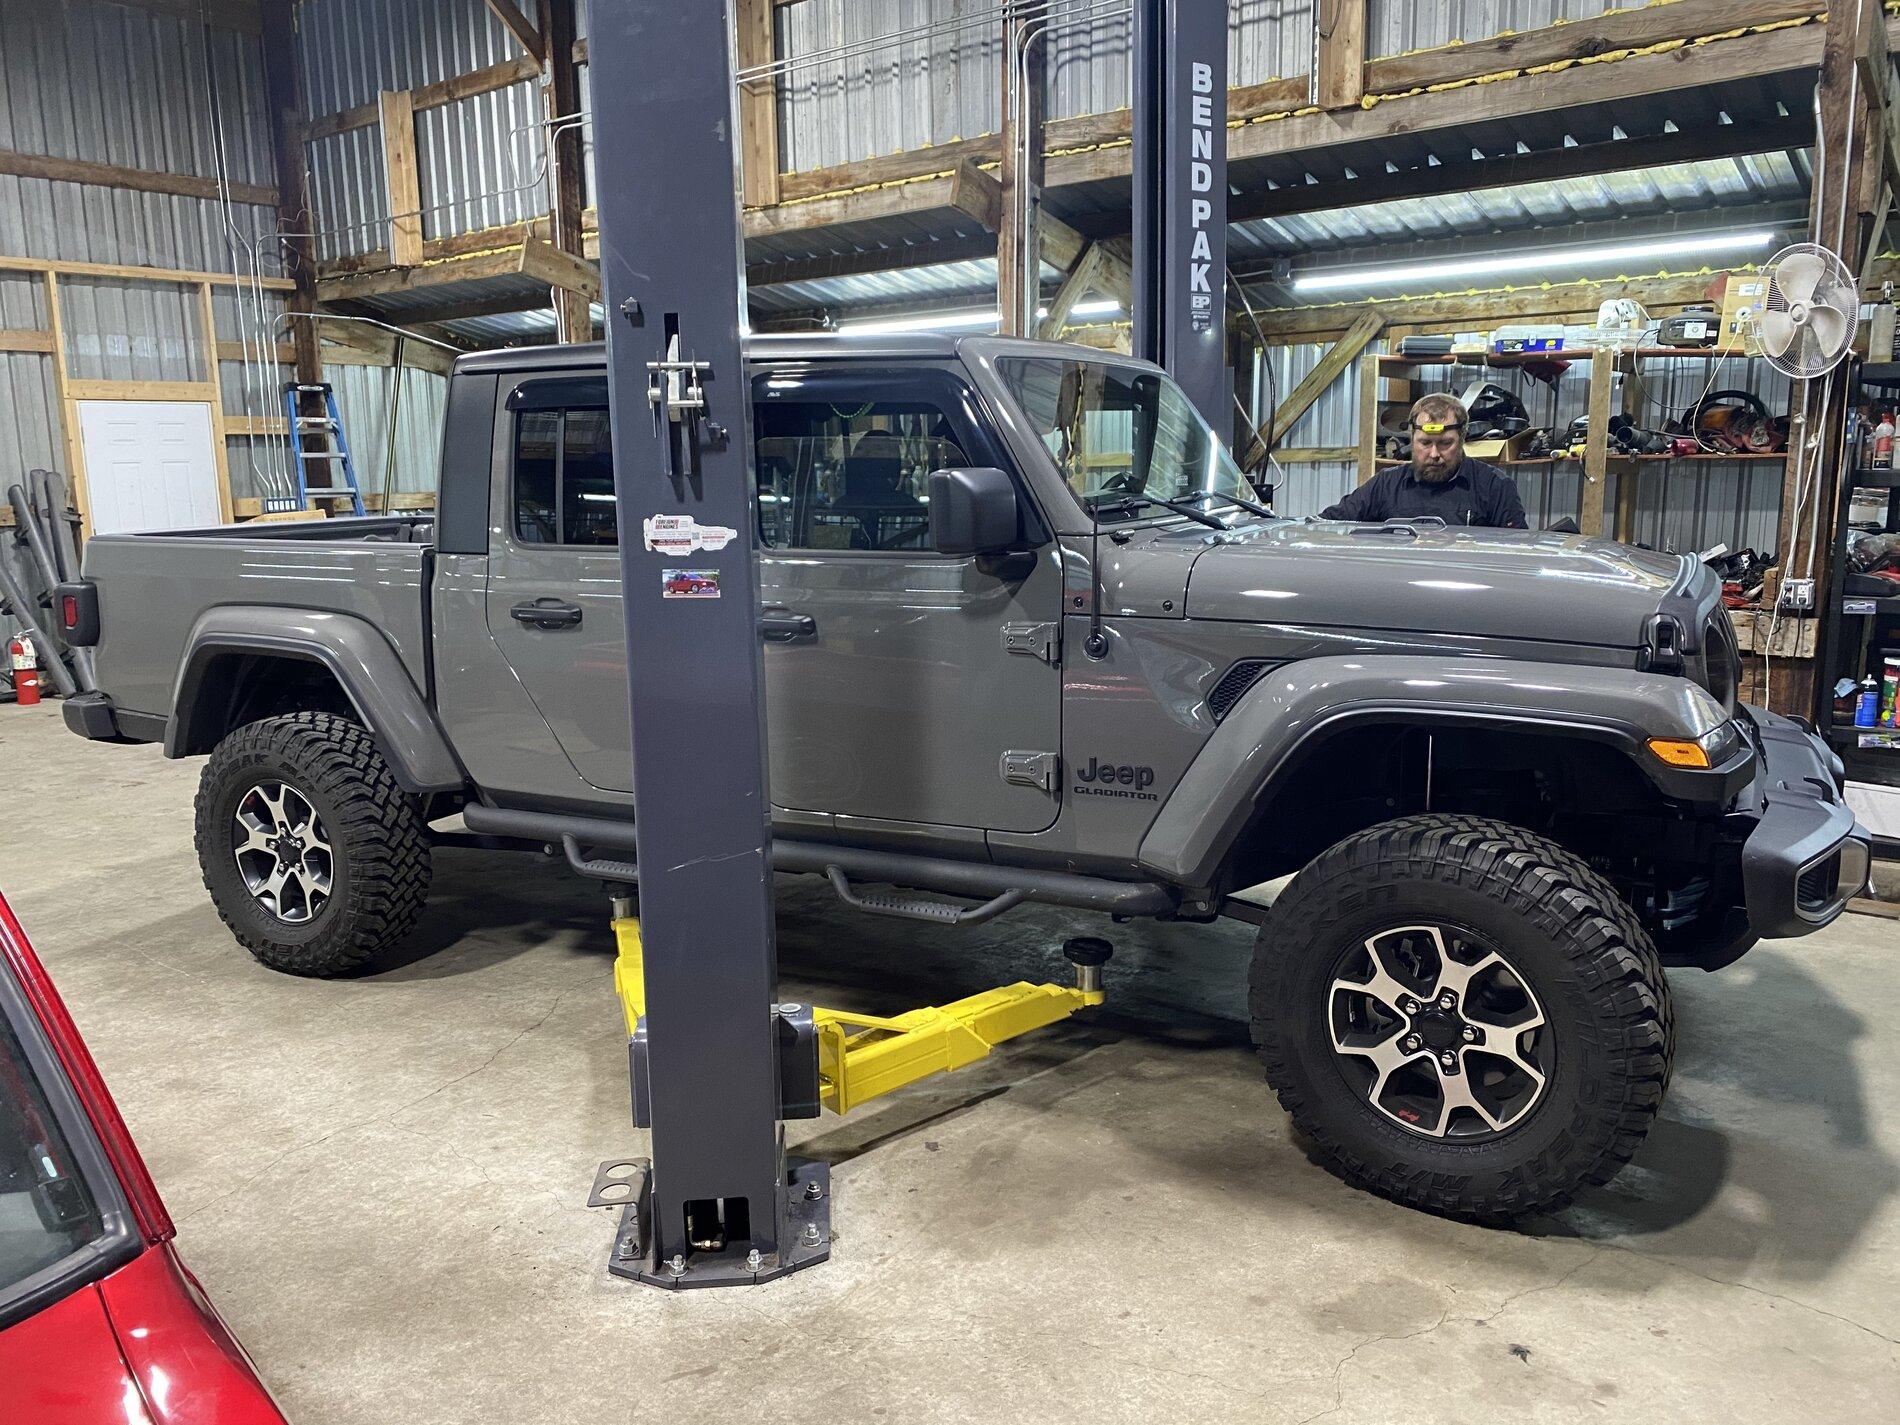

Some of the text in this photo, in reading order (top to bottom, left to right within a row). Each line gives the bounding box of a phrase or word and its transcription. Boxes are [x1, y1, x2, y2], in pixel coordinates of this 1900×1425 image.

[1190, 61, 1213, 292] BENDPAK
[1076, 756, 1154, 791] Jeep
[1073, 786, 1158, 801] GLADIATOR
